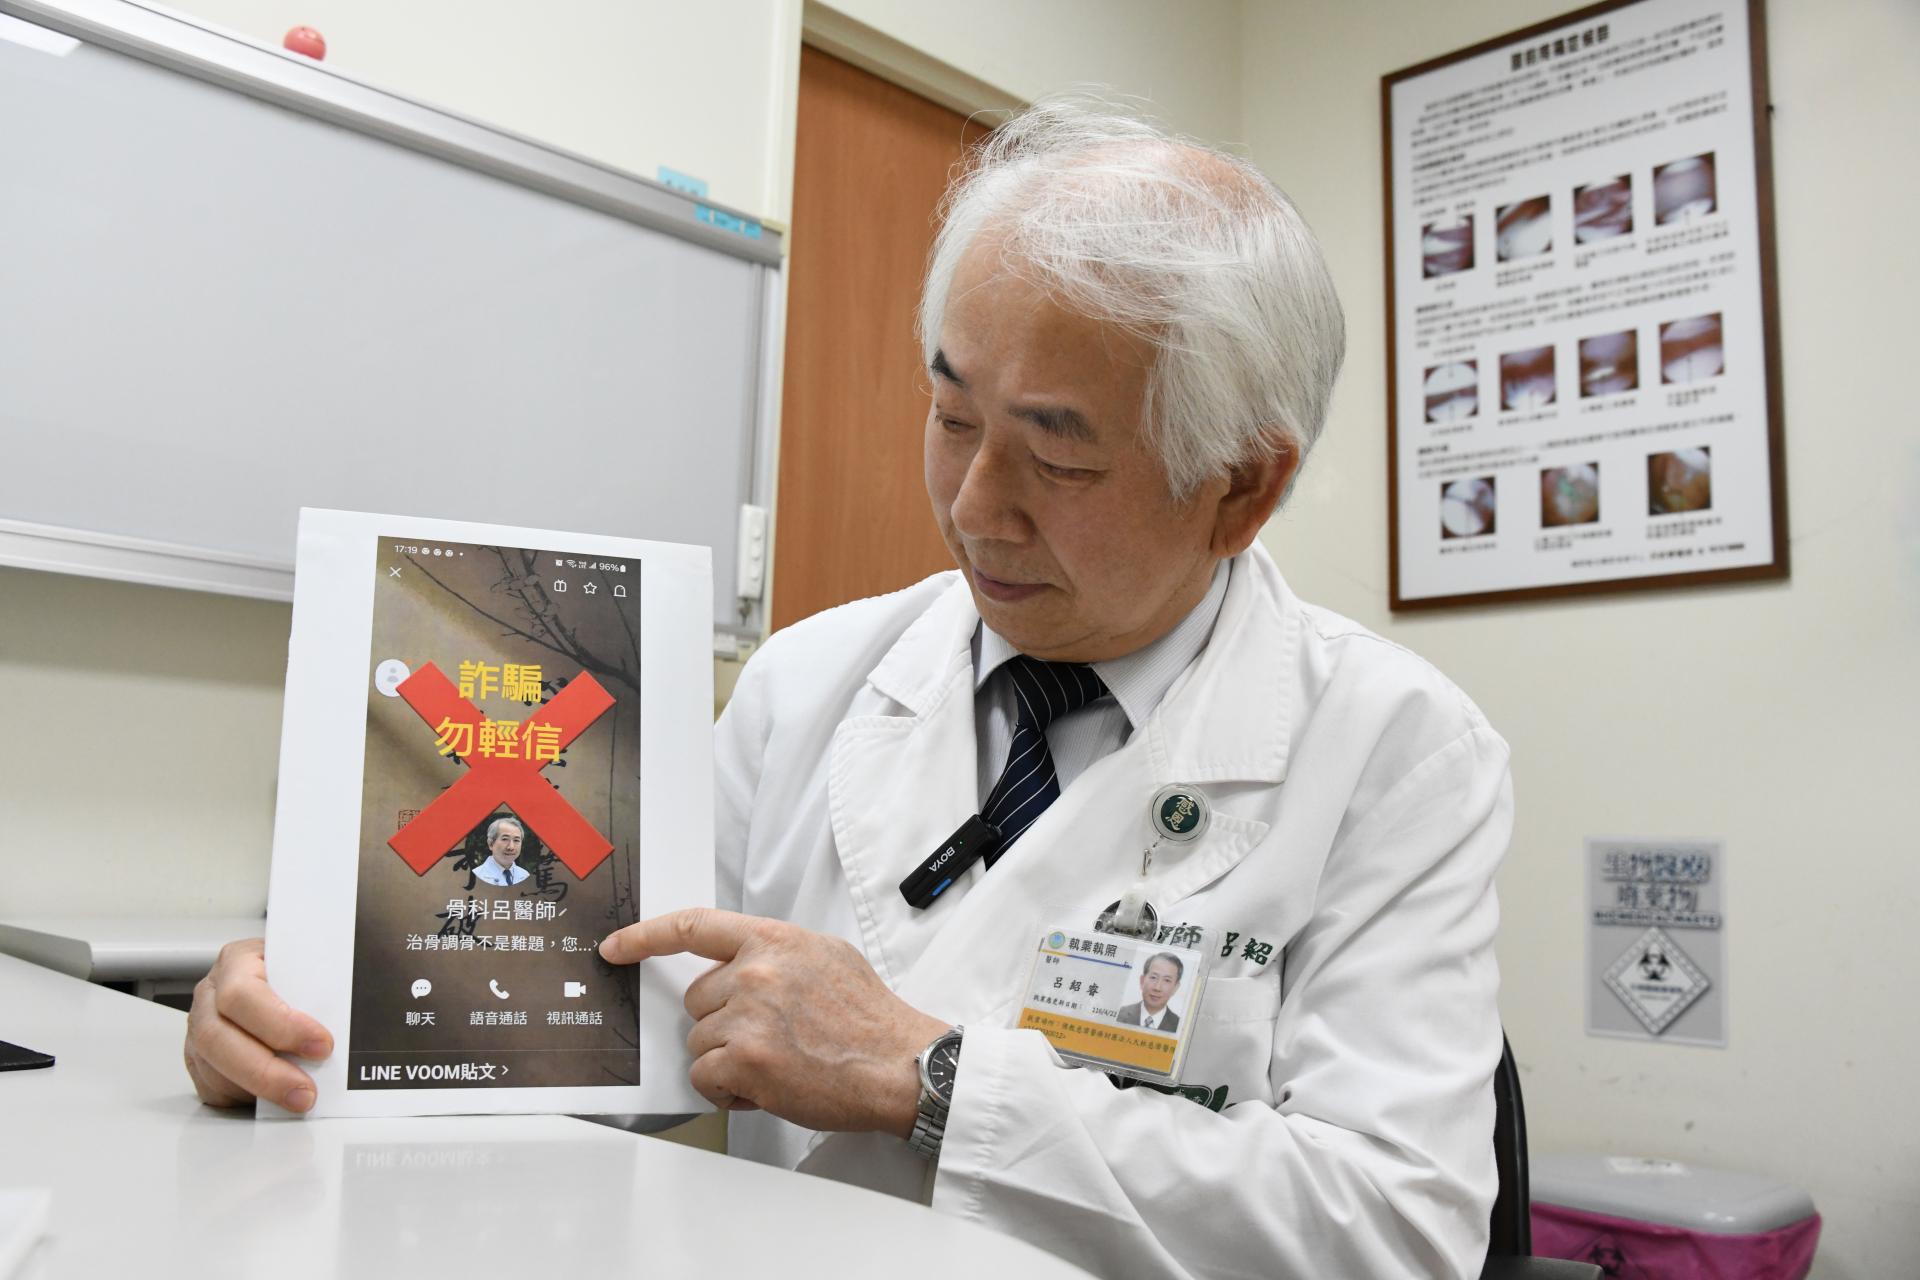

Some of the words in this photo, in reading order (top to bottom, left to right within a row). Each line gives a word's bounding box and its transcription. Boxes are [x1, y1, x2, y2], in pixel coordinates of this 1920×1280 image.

[394, 545, 417, 555] 17:19
[599, 562, 620, 573] 96%
[458, 660, 542, 703] 詐騙
[434, 716, 563, 762] 勿輕信
[1165, 796, 1194, 831] 感恩
[929, 847, 955, 873] BOYA
[446, 899, 557, 921] 骨科呂醫師
[1068, 937, 1118, 958] 執業執照
[405, 1011, 435, 1026] 聊天
[470, 1011, 527, 1025] 語音通話
[546, 1011, 603, 1025] 視訊通話
[360, 1065, 402, 1081] LINE
[405, 1063, 496, 1081] VOOM貼文
